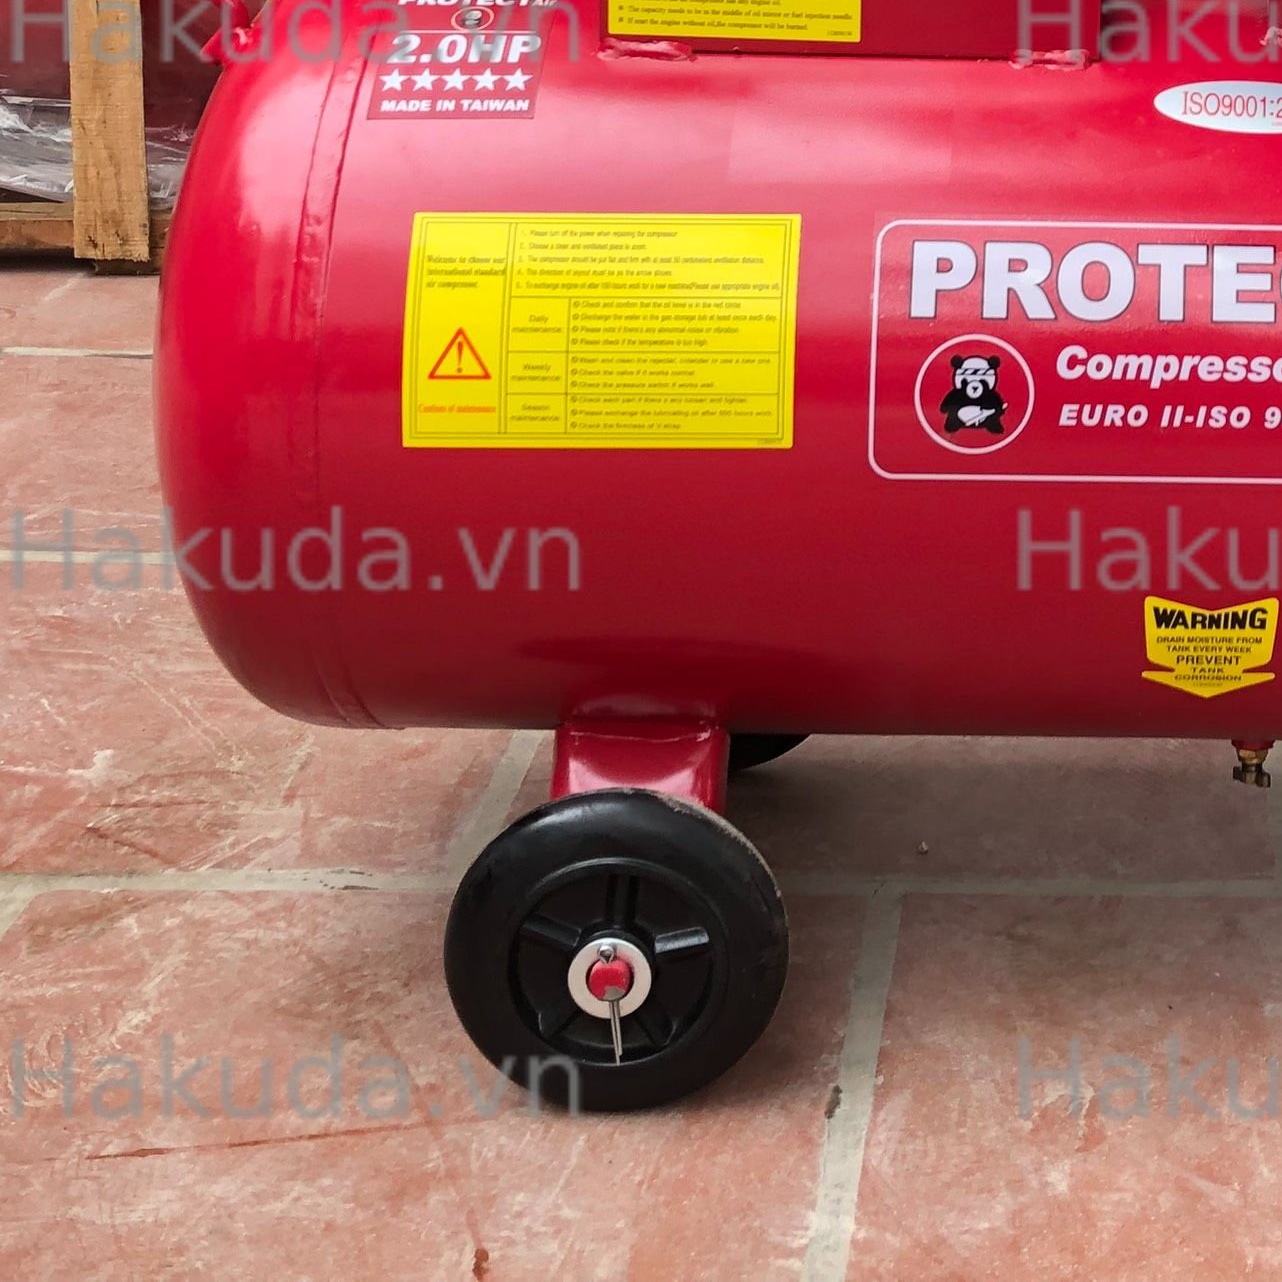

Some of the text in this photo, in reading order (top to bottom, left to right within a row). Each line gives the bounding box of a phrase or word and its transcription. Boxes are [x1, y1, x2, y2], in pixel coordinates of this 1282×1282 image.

[386, 34, 542, 64] 2.0HP
[380, 99, 529, 112] MADE IN TAIWAN
[1058, 404, 1149, 428] EURO
[1159, 405, 1251, 429] II-ISO
[1153, 606, 1268, 630] WARNING
[1157, 636, 1263, 645] DRAIN MOISTURE FROM
[1167, 645, 1190, 653] TANK
[1176, 654, 1241, 666] PREVENT
